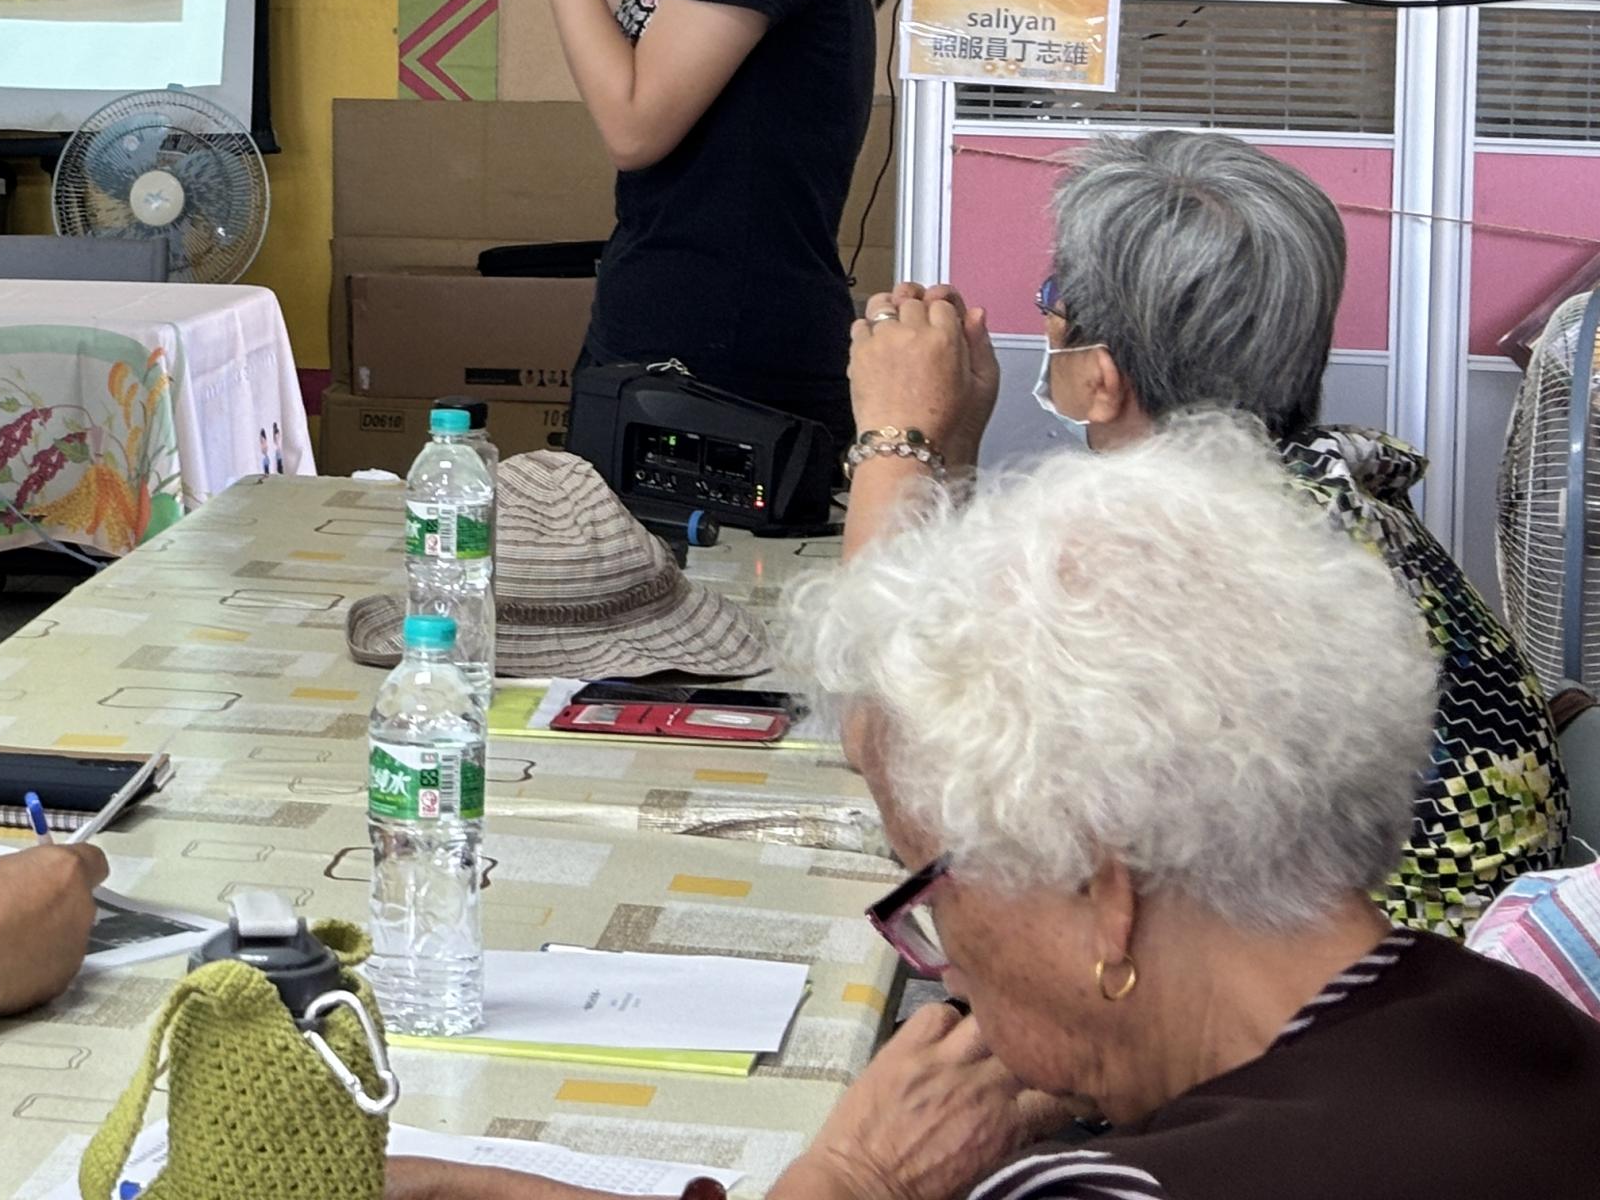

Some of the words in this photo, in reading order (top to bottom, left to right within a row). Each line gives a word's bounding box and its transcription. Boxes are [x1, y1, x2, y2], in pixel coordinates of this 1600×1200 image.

[967, 7, 1057, 36] saliyan
[932, 35, 1089, 66] 照服員丁志雄
